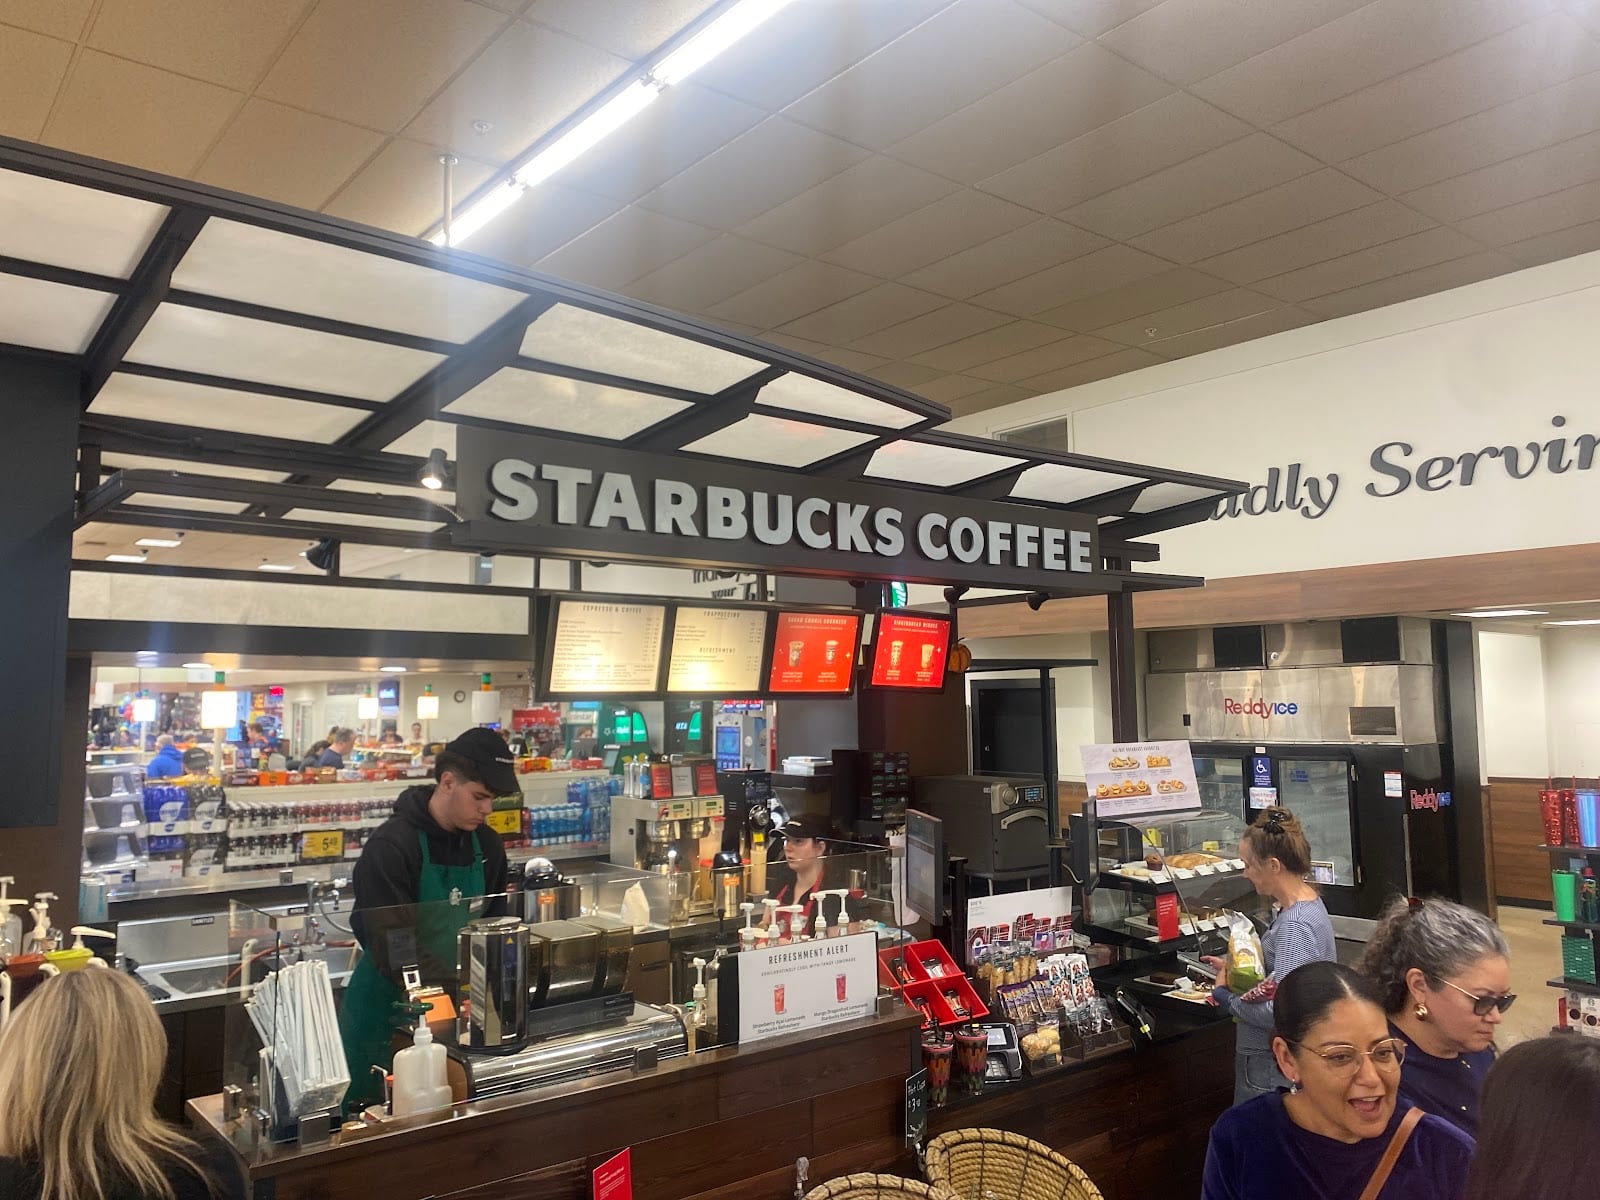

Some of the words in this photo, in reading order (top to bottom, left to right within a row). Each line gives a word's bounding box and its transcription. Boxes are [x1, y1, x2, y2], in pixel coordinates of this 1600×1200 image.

[489, 458, 906, 557] STARBUCKS
[917, 512, 1093, 573] COFFEE
[768, 948, 823, 965] REFRESHMENT
[826, 944, 849, 956] ALERT
